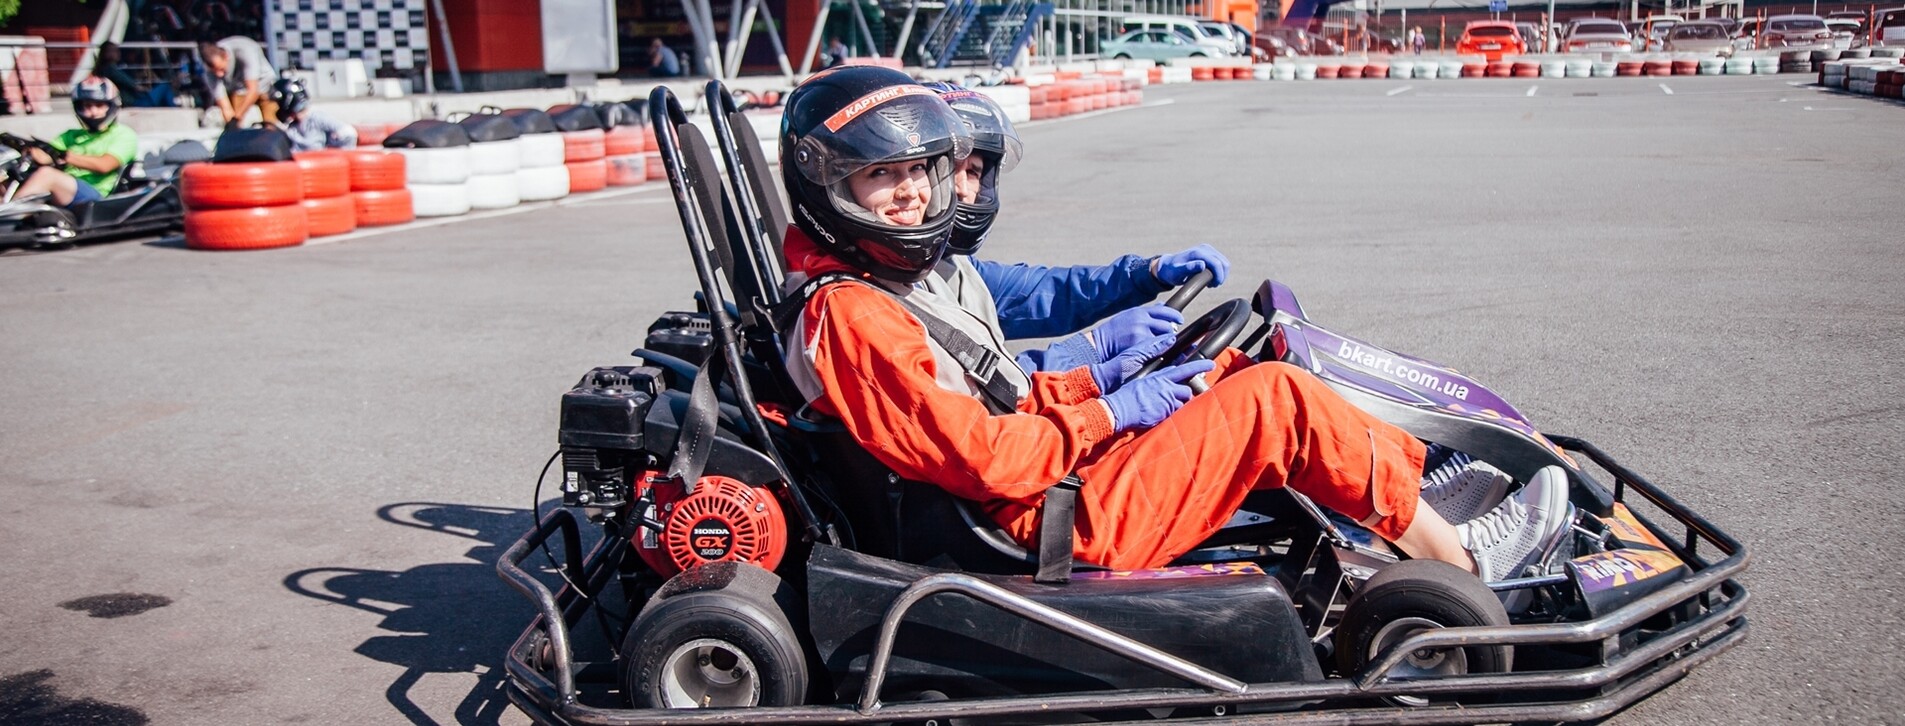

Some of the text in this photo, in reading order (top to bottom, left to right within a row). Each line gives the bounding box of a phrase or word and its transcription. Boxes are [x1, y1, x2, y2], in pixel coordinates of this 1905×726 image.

[845, 88, 901, 118] КАРТИНГ
[1337, 341, 1469, 400] bkart.com.ua
[695, 536, 727, 548] GX
[700, 548, 724, 556] 200
